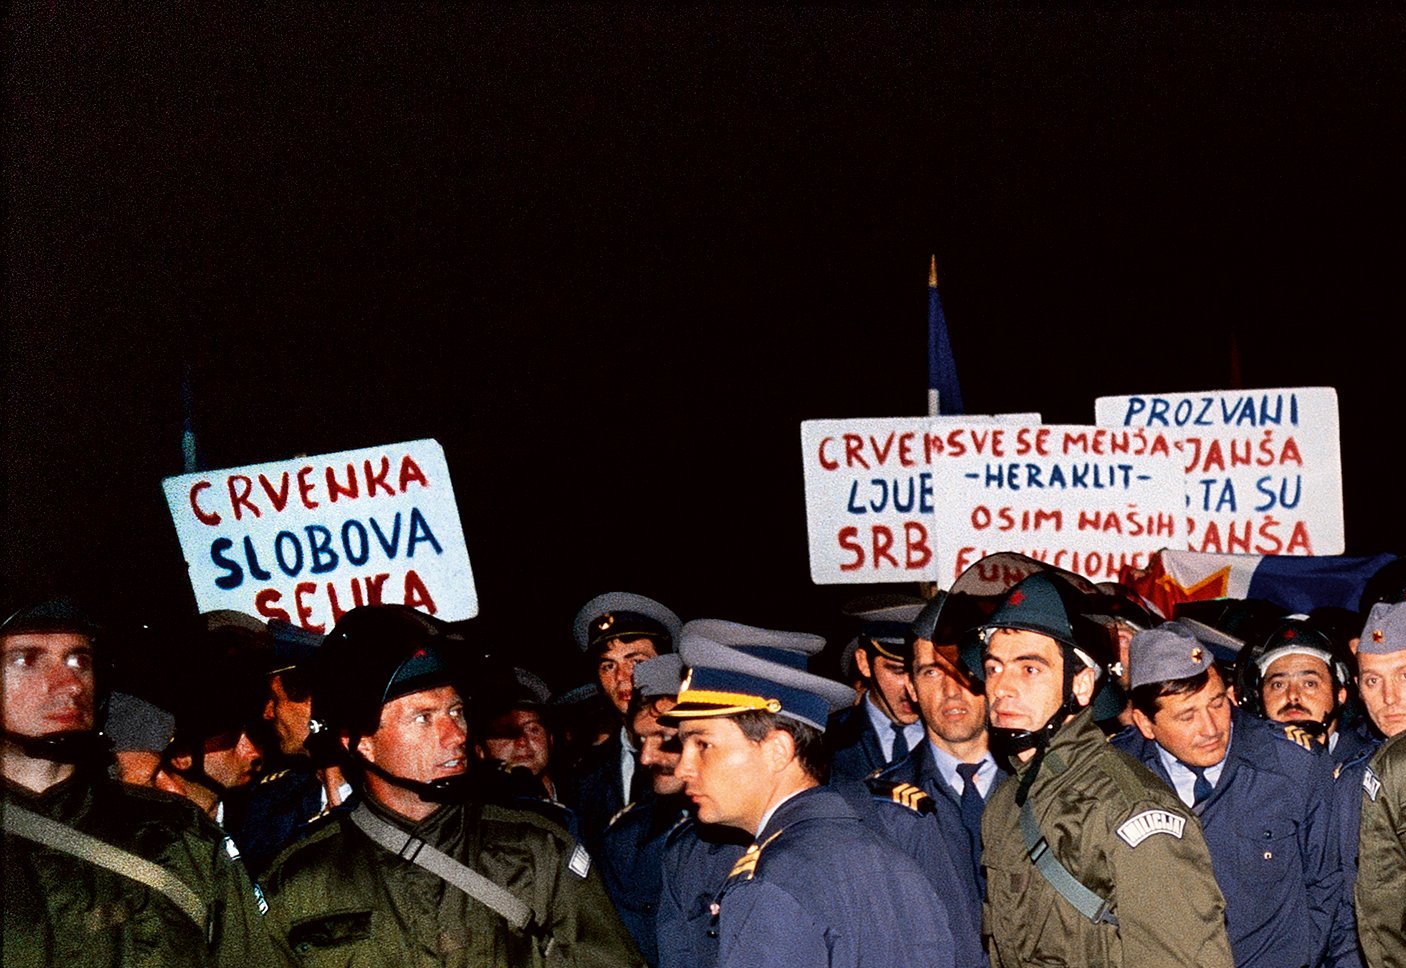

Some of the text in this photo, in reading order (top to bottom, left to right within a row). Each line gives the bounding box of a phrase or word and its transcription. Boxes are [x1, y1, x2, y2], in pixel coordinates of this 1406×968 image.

[1124, 393, 1299, 428] PROZVANI
[1015, 428, 1051, 456] SE
[189, 454, 428, 526] CRVENKA
[1255, 475, 1301, 512] SU
[971, 503, 1174, 538] OSIM NAŠIH
[210, 507, 443, 590] SLOBOVA
[837, 521, 932, 572] SRB
